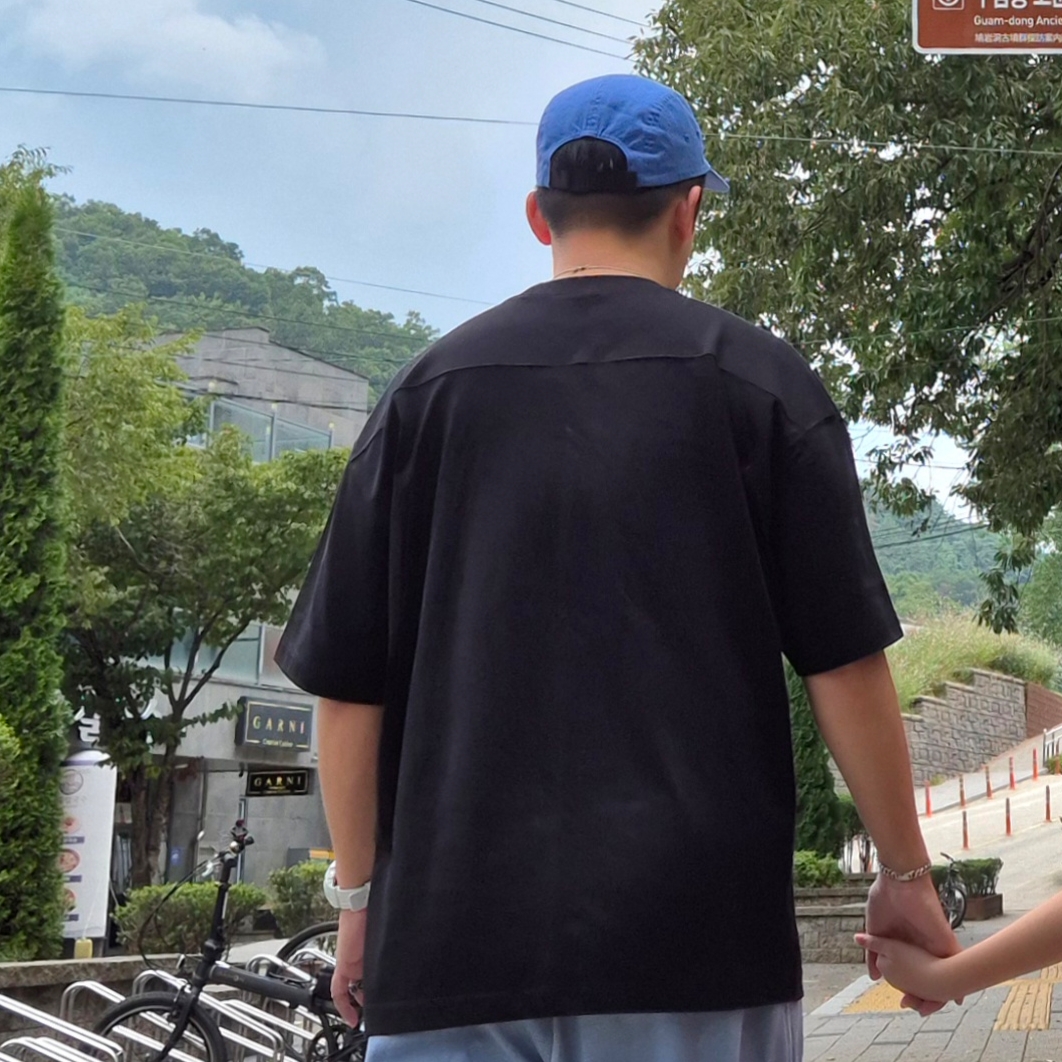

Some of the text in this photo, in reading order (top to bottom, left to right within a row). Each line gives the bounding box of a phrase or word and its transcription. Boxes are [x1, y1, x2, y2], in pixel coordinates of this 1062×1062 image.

[974, 14, 1034, 28] Guam-dong
[253, 715, 305, 734] GARNI
[254, 776, 302, 787] GARNI
